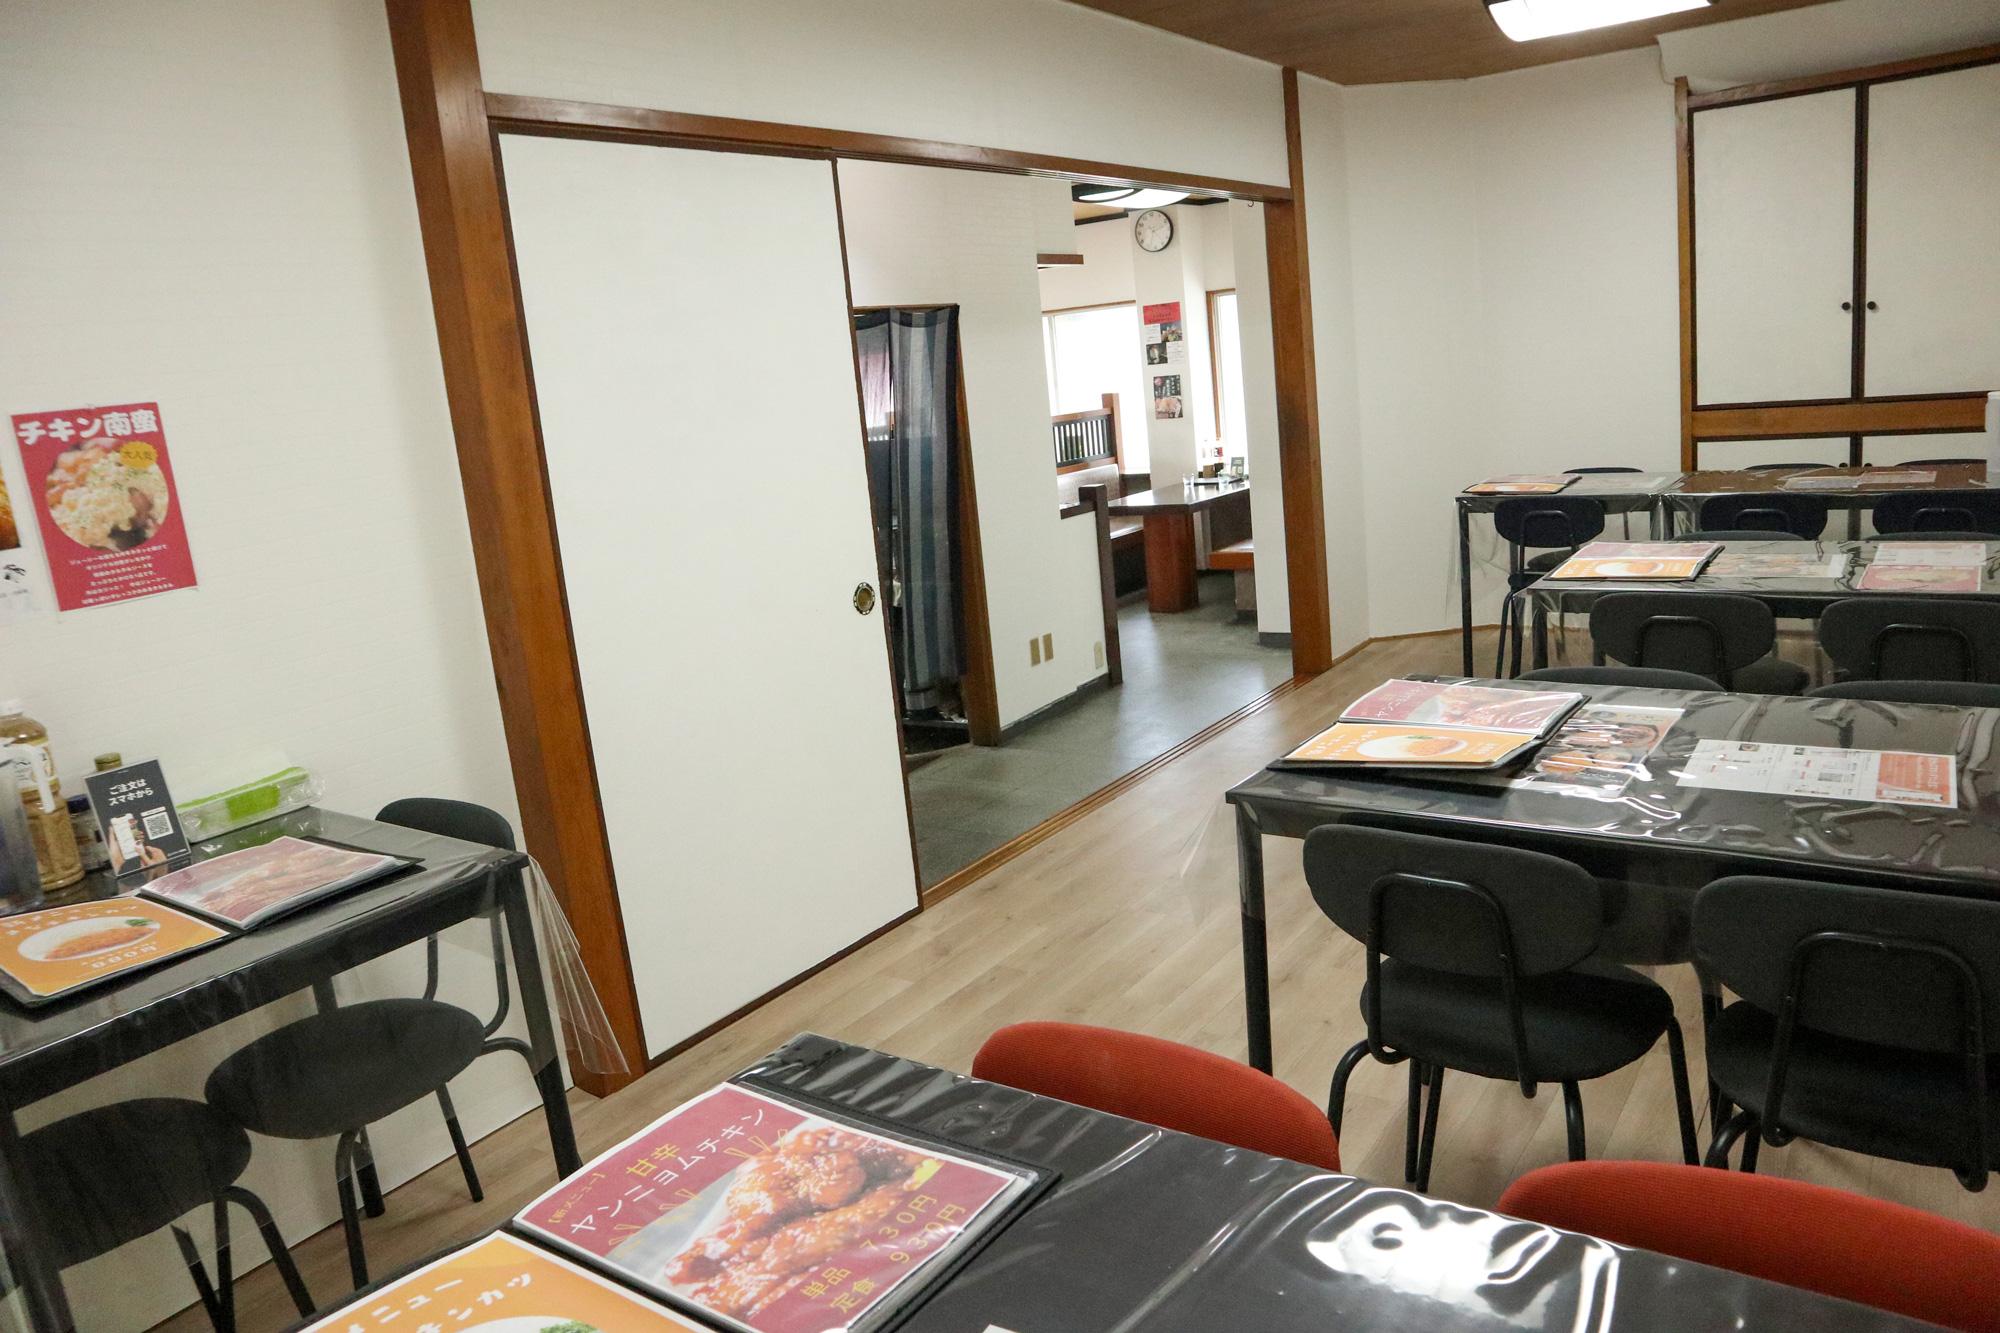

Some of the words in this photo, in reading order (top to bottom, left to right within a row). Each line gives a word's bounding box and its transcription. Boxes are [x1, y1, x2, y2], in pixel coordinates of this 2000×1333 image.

[17, 409, 158, 445] チキン南蛮
[108, 787, 153, 806] スマホから
[109, 778, 147, 795] ご注文は
[570, 1108, 764, 1234] ヤンニョムチキン
[626, 1143, 681, 1177] 甘辛
[802, 1267, 852, 1299] 単品
[830, 1277, 877, 1313] 定食
